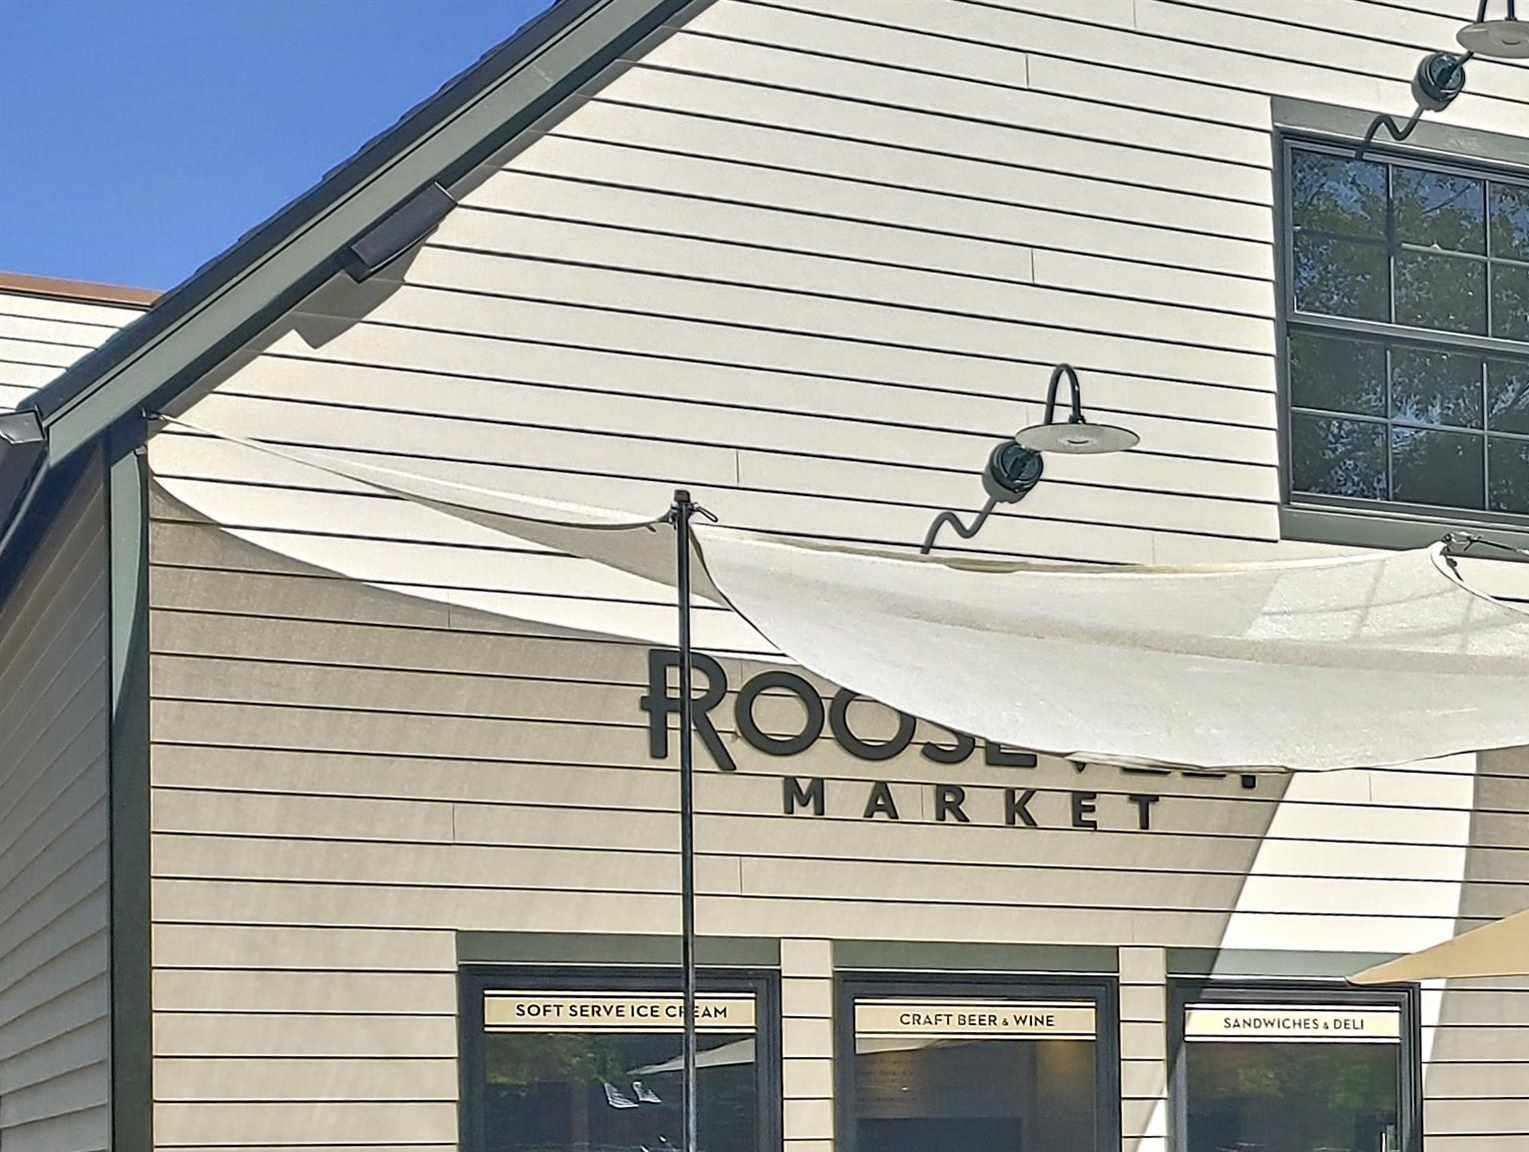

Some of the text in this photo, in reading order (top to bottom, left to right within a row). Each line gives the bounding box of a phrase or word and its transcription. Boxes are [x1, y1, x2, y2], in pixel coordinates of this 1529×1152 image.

[782, 776, 1160, 831] MARKET
[516, 1003, 564, 1017] SOFT
[569, 1004, 625, 1018] SERVE
[630, 1005, 661, 1018] ICE
[899, 1013, 1055, 1027] CRAFT BEER & WINE
[1223, 1017, 1364, 1030] SANDWICHES & DELI
